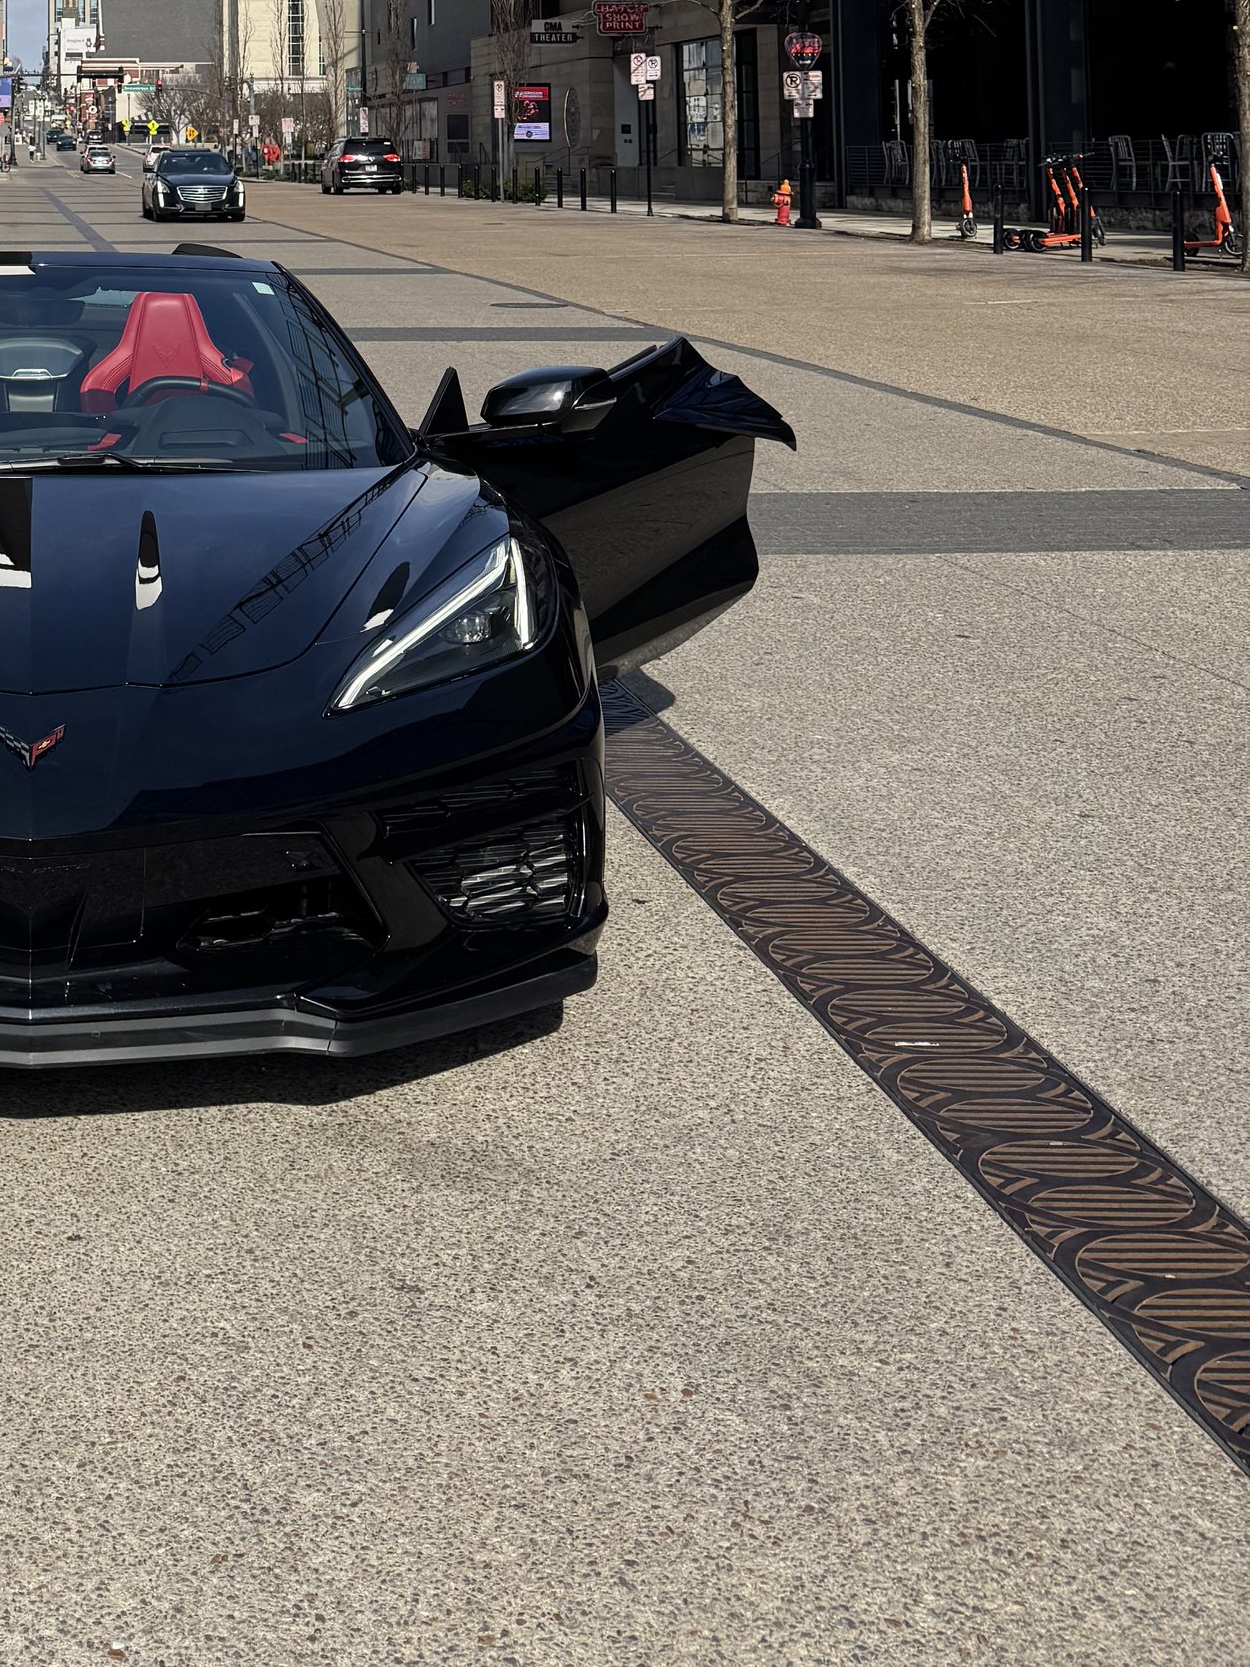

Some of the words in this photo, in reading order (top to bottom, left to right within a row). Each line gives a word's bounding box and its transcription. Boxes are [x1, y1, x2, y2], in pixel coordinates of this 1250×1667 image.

[606, 13, 640, 22] SHOW
[605, 21, 641, 29] PRINT
[534, 33, 573, 42] THEATER
